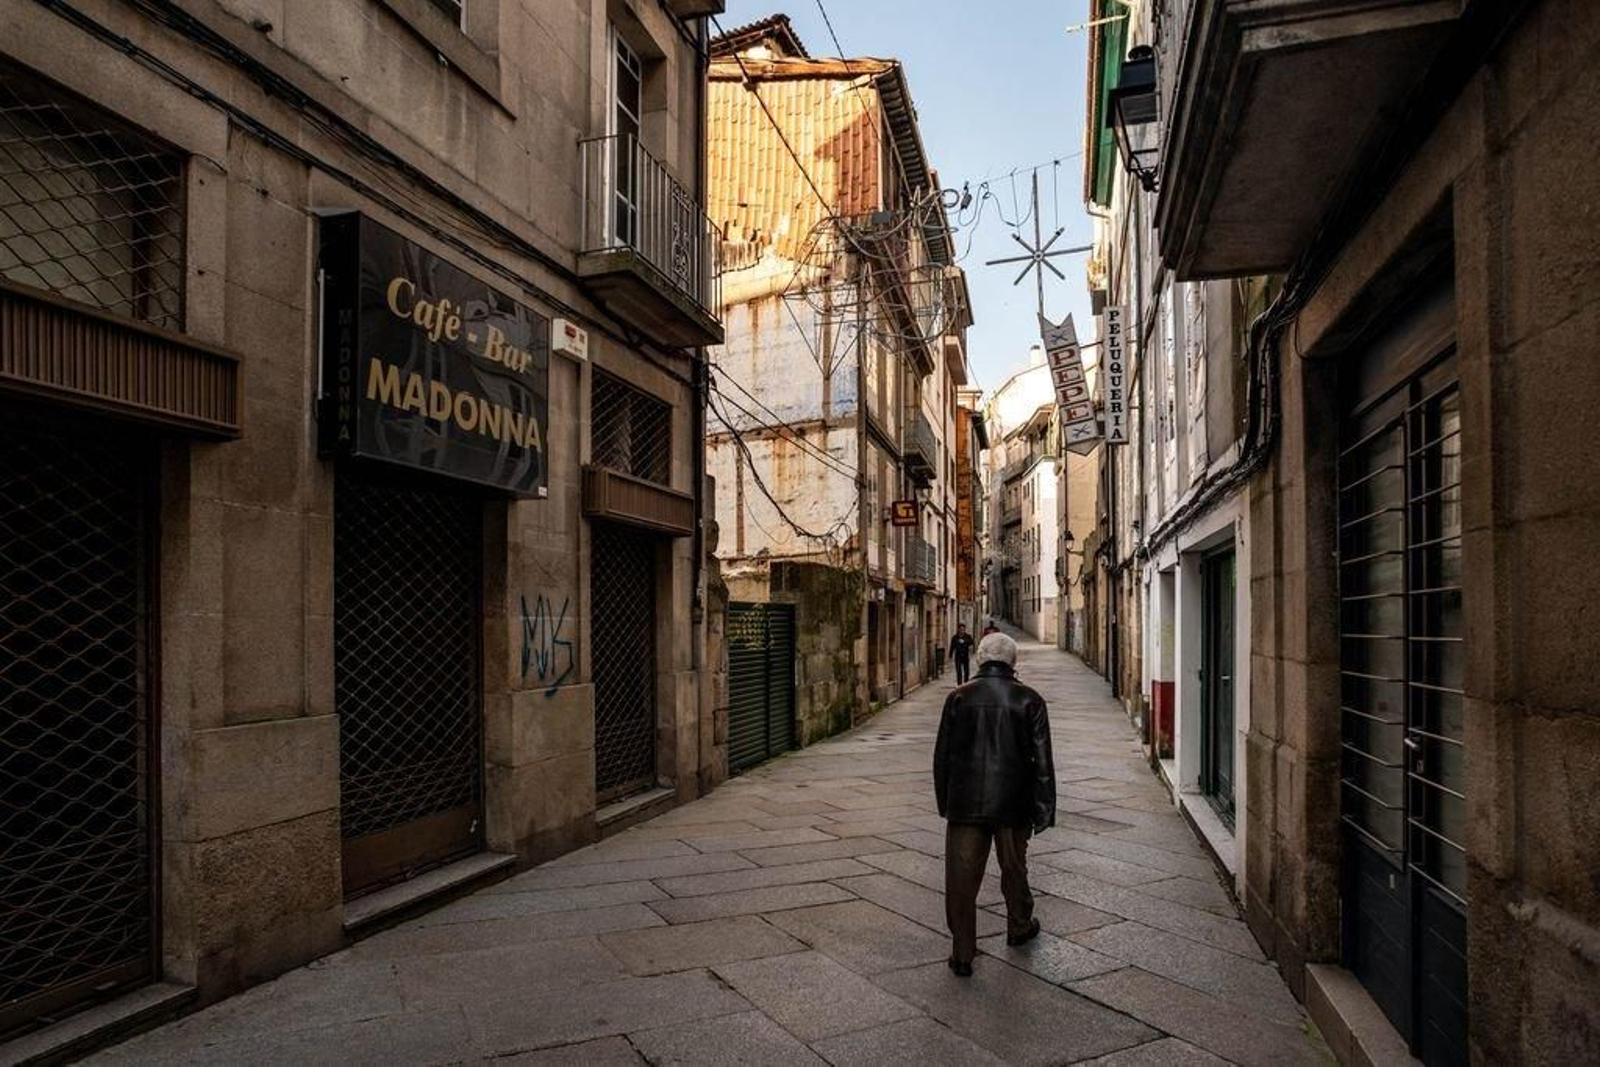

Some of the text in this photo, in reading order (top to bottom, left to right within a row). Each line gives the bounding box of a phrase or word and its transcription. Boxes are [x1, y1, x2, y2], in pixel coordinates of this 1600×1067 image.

[338, 308, 351, 440] MADONNA
[387, 277, 461, 342] Café
[485, 324, 533, 374] Bar
[366, 357, 542, 453] MADONNA
[1049, 347, 1090, 422] PEPE
[1108, 310, 1123, 440] PELUQUERIA
